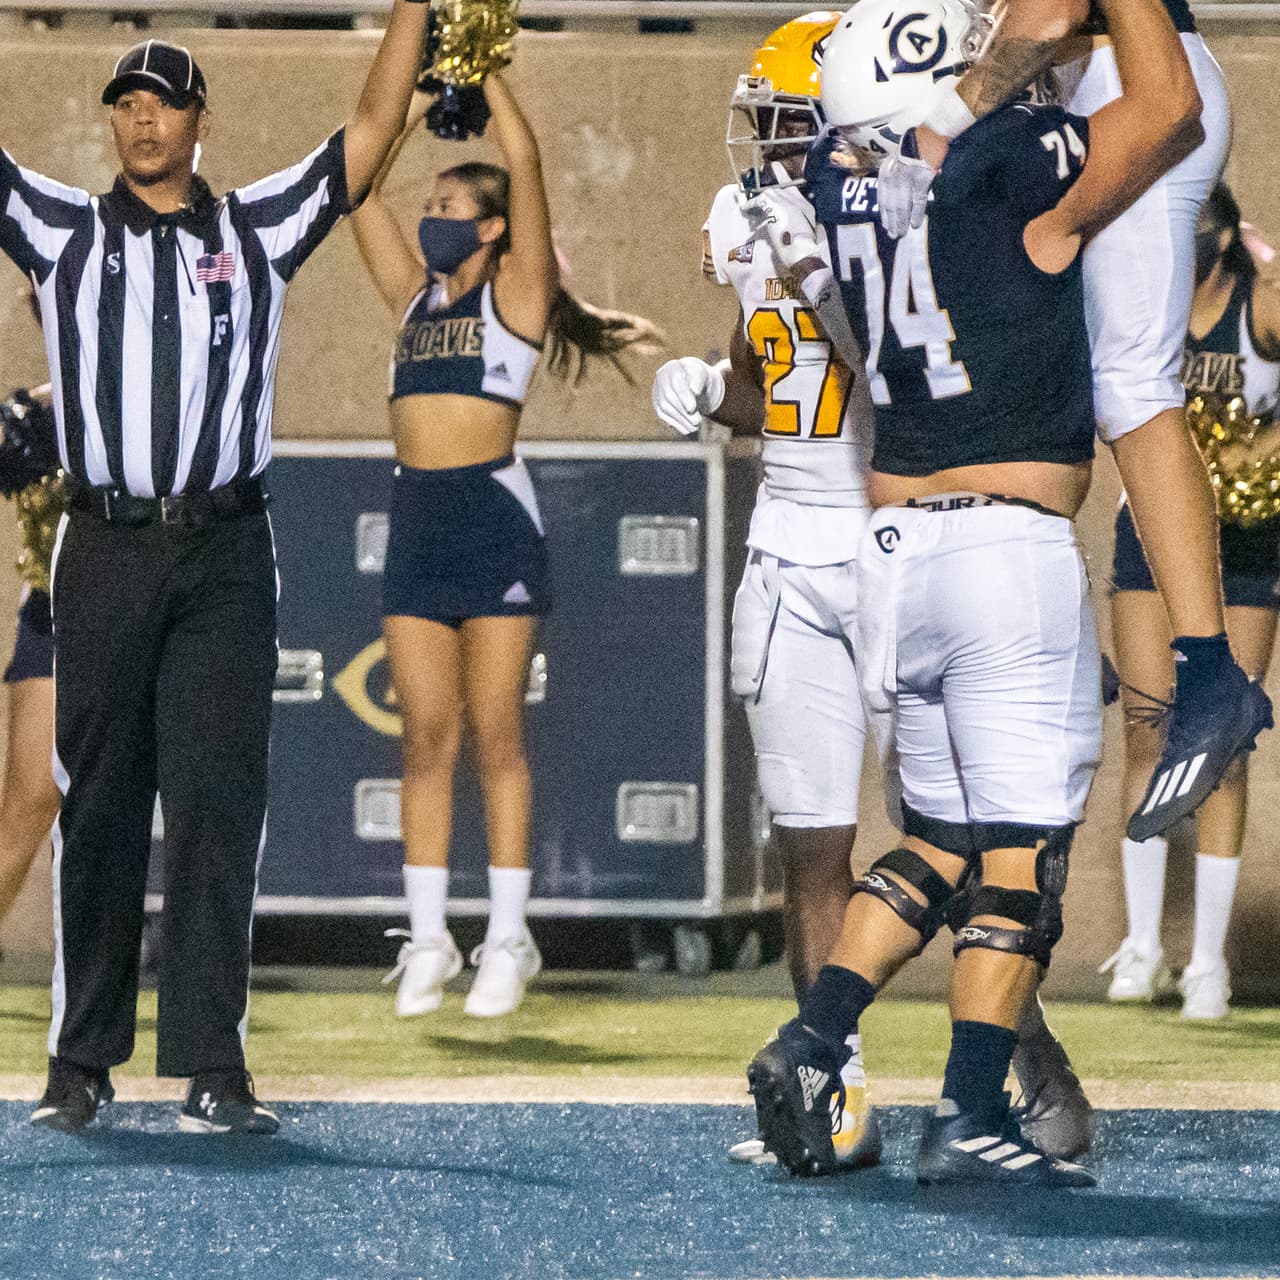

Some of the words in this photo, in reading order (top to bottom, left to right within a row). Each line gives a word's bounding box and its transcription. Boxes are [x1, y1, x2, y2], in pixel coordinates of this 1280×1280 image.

[212, 314, 229, 345] F
[748, 306, 857, 439] 27
[836, 216, 973, 406] 74
